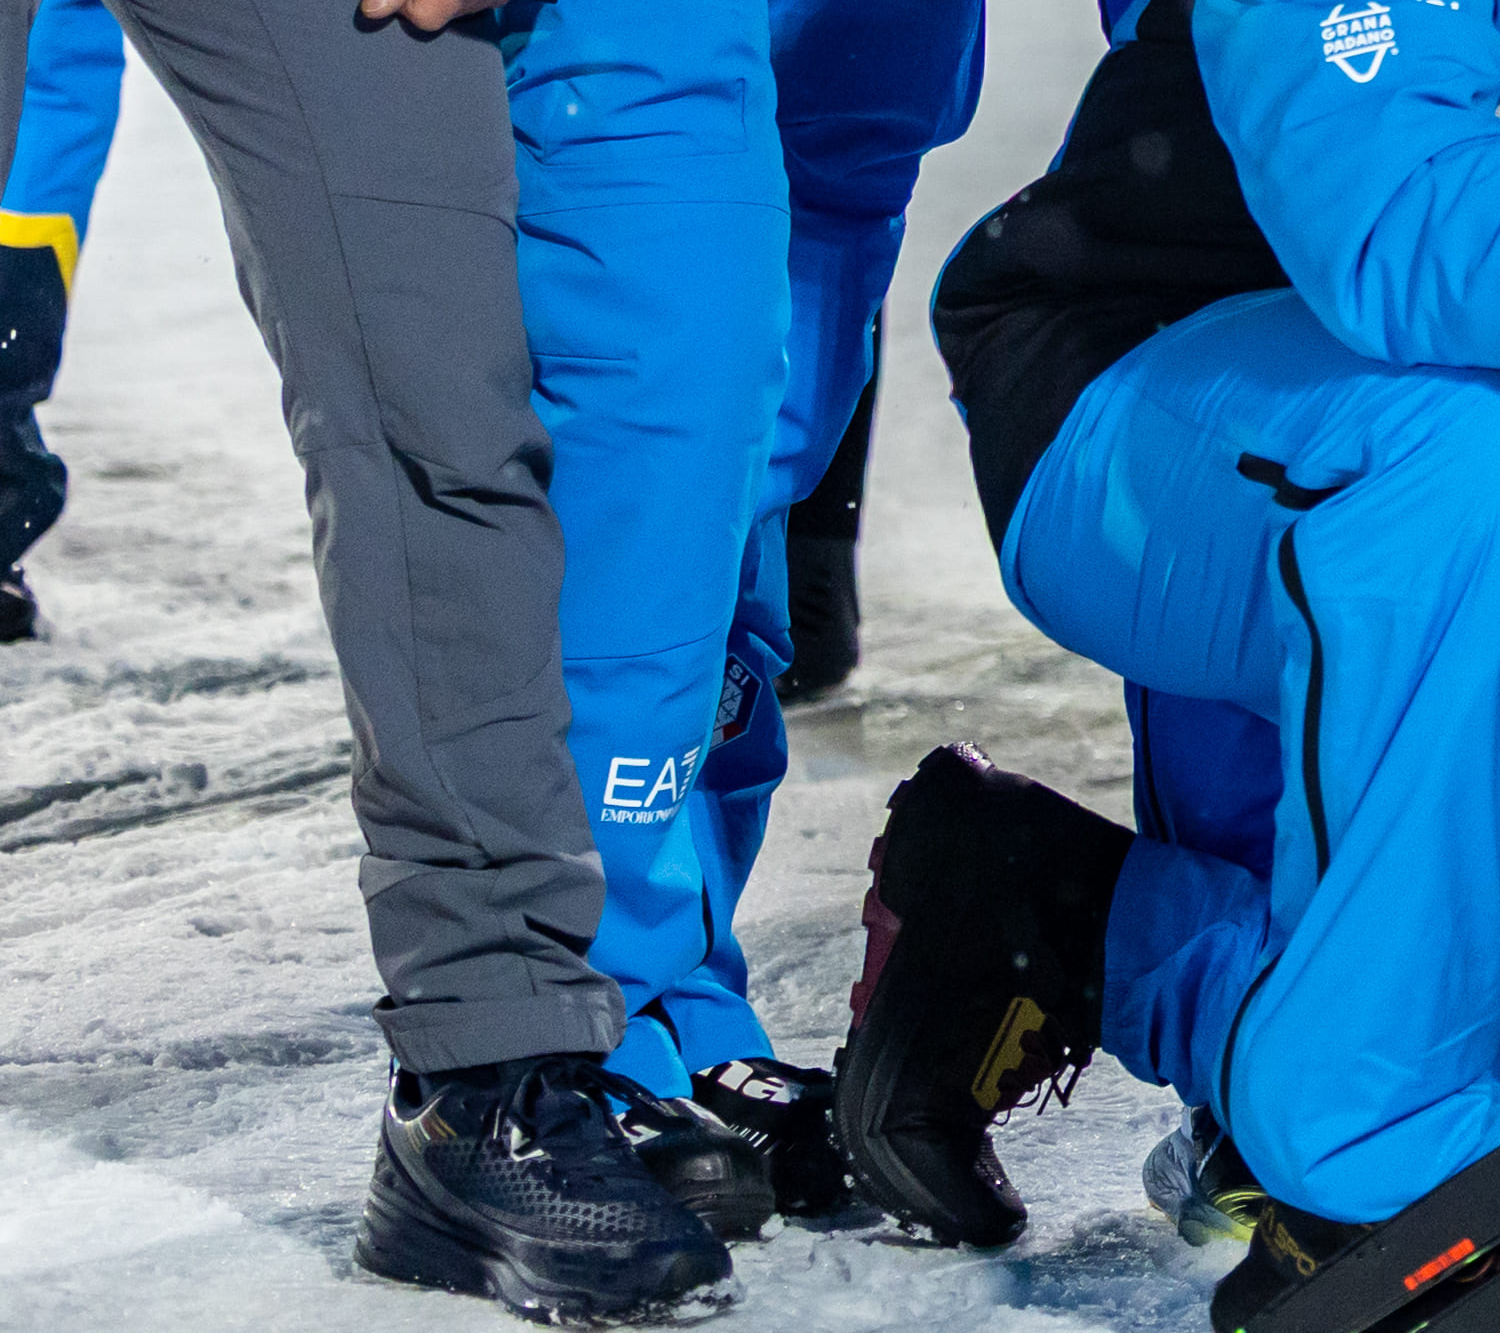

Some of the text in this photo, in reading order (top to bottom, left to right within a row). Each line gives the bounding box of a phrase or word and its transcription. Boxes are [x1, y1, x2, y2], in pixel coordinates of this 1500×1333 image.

[1321, 12, 1392, 43] GRANA
[1323, 25, 1394, 58] PADANO
[605, 748, 698, 809] EA7
